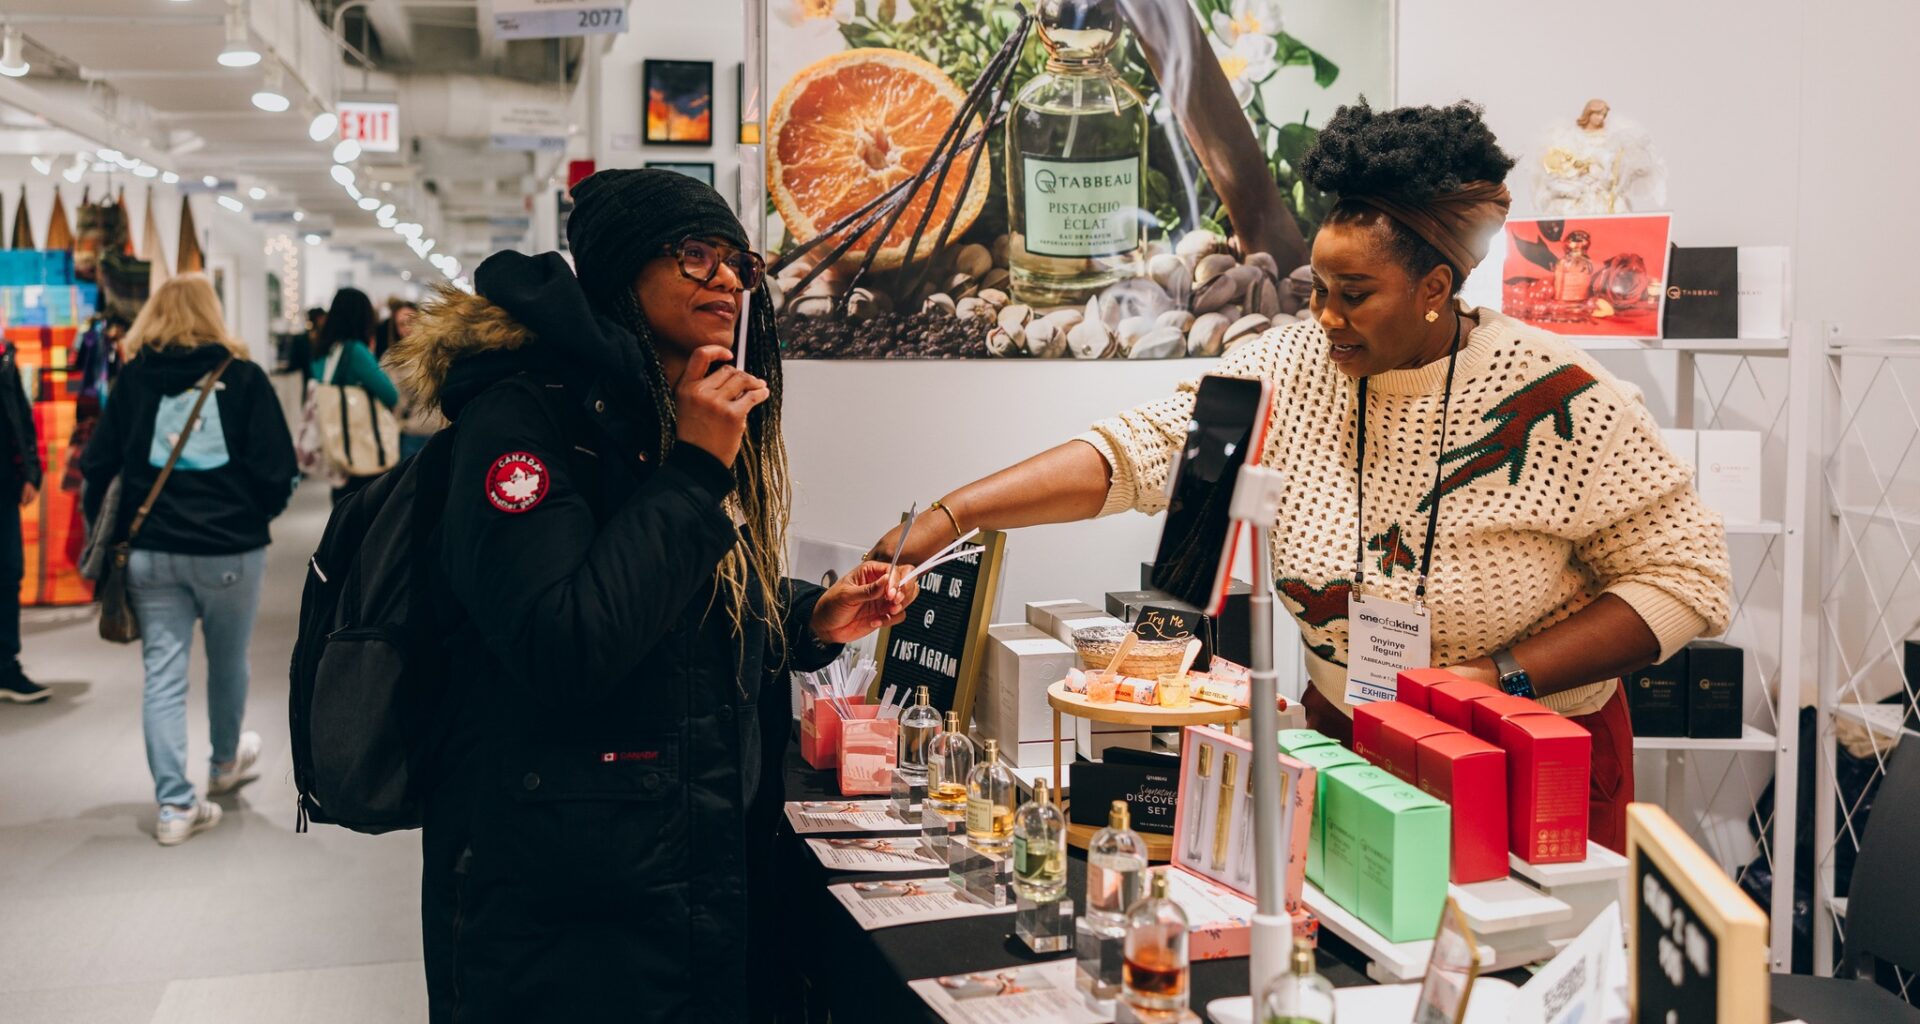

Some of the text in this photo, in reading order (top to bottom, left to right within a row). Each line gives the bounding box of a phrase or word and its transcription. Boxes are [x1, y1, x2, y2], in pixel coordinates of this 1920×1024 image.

[578, 8, 623, 28] 2077
[340, 111, 389, 142] EXIT
[1059, 172, 1132, 189] TABBEAU
[1048, 201, 1121, 214] PISTACHIO
[1063, 216, 1107, 230] ÉCLAT
[498, 454, 542, 472] CANADA
[949, 578, 962, 598] US
[924, 610, 935, 628] @
[1147, 611, 1184, 633] Try Me
[1359, 612, 1419, 632] oneofakind
[1370, 635, 1406, 650] Onyinye
[1372, 644, 1402, 658] Ifeguni
[1361, 686, 1397, 701] EXHIBIT
[1147, 806, 1167, 815] SET
